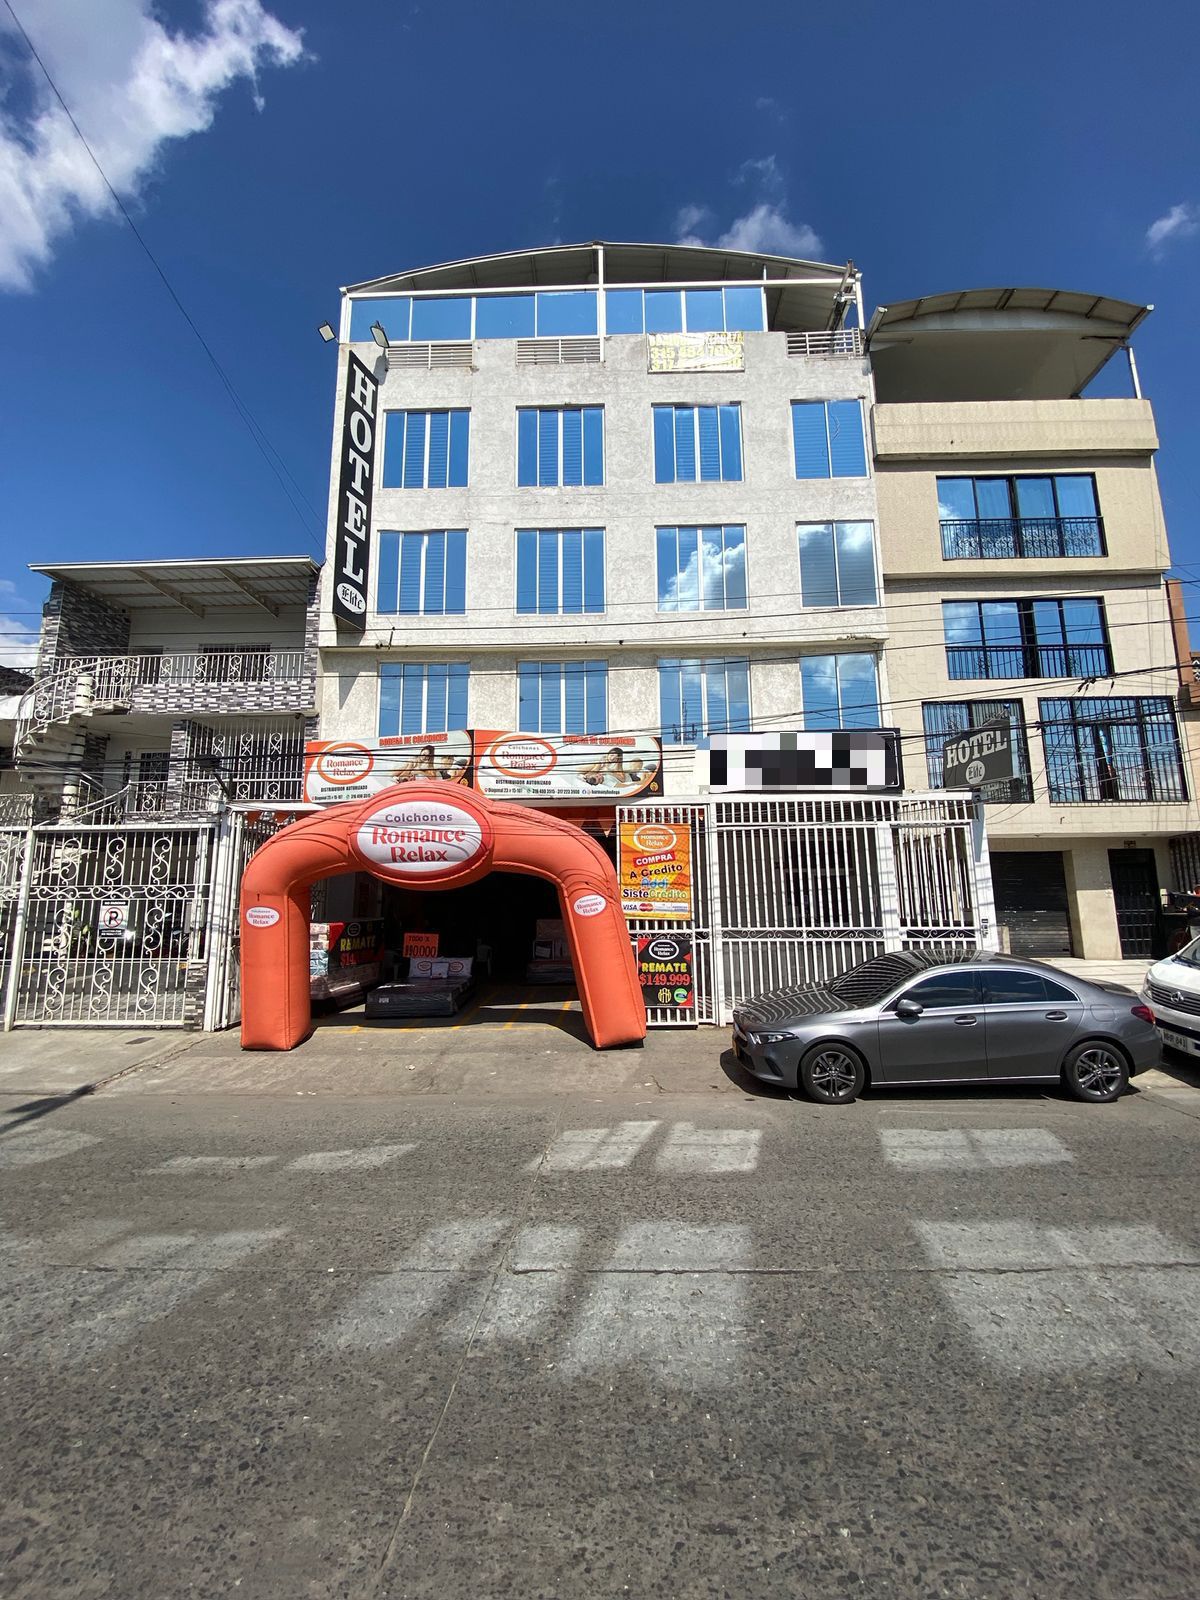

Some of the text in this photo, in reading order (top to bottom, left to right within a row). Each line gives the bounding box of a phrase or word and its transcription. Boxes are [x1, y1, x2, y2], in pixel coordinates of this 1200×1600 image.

[343, 363, 377, 584] HOTEL
[945, 730, 1008, 769] HOTEL
[326, 759, 364, 768] Romance
[333, 767, 356, 777] Relax
[385, 812, 453, 823] Colchones
[372, 827, 466, 844] Romance
[390, 846, 449, 863] Relax
[635, 853, 673, 866] COMPRA
[630, 864, 683, 879] A Credito
[641, 962, 688, 973] REMATE
[639, 973, 691, 987] $149.999
